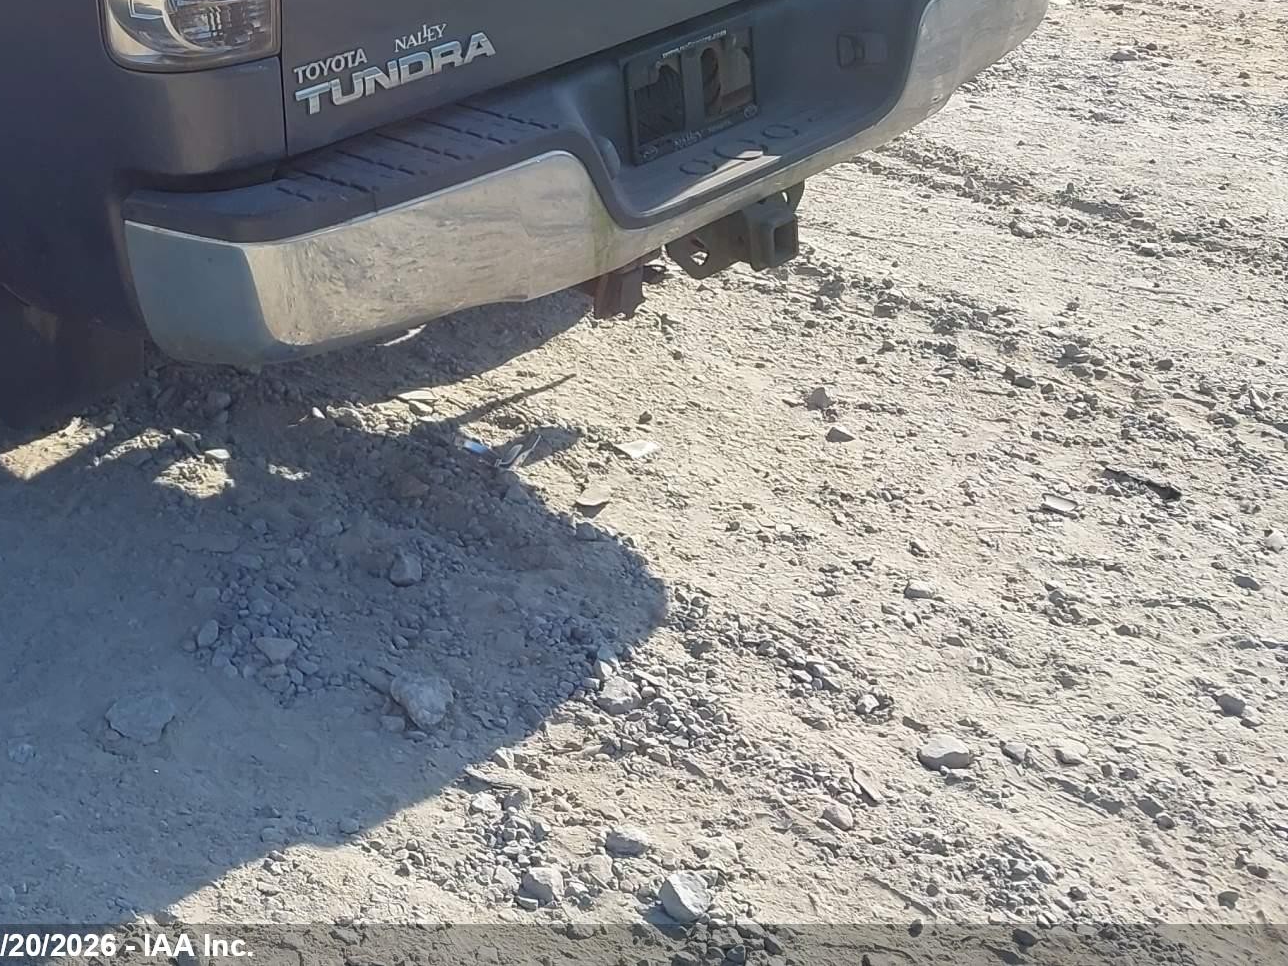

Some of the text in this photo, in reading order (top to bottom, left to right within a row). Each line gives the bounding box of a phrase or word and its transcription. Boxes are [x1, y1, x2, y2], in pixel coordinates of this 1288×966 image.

[394, 23, 447, 53] NALLEY
[293, 48, 369, 84] TOYOTA
[294, 31, 497, 115] TUNDRA
